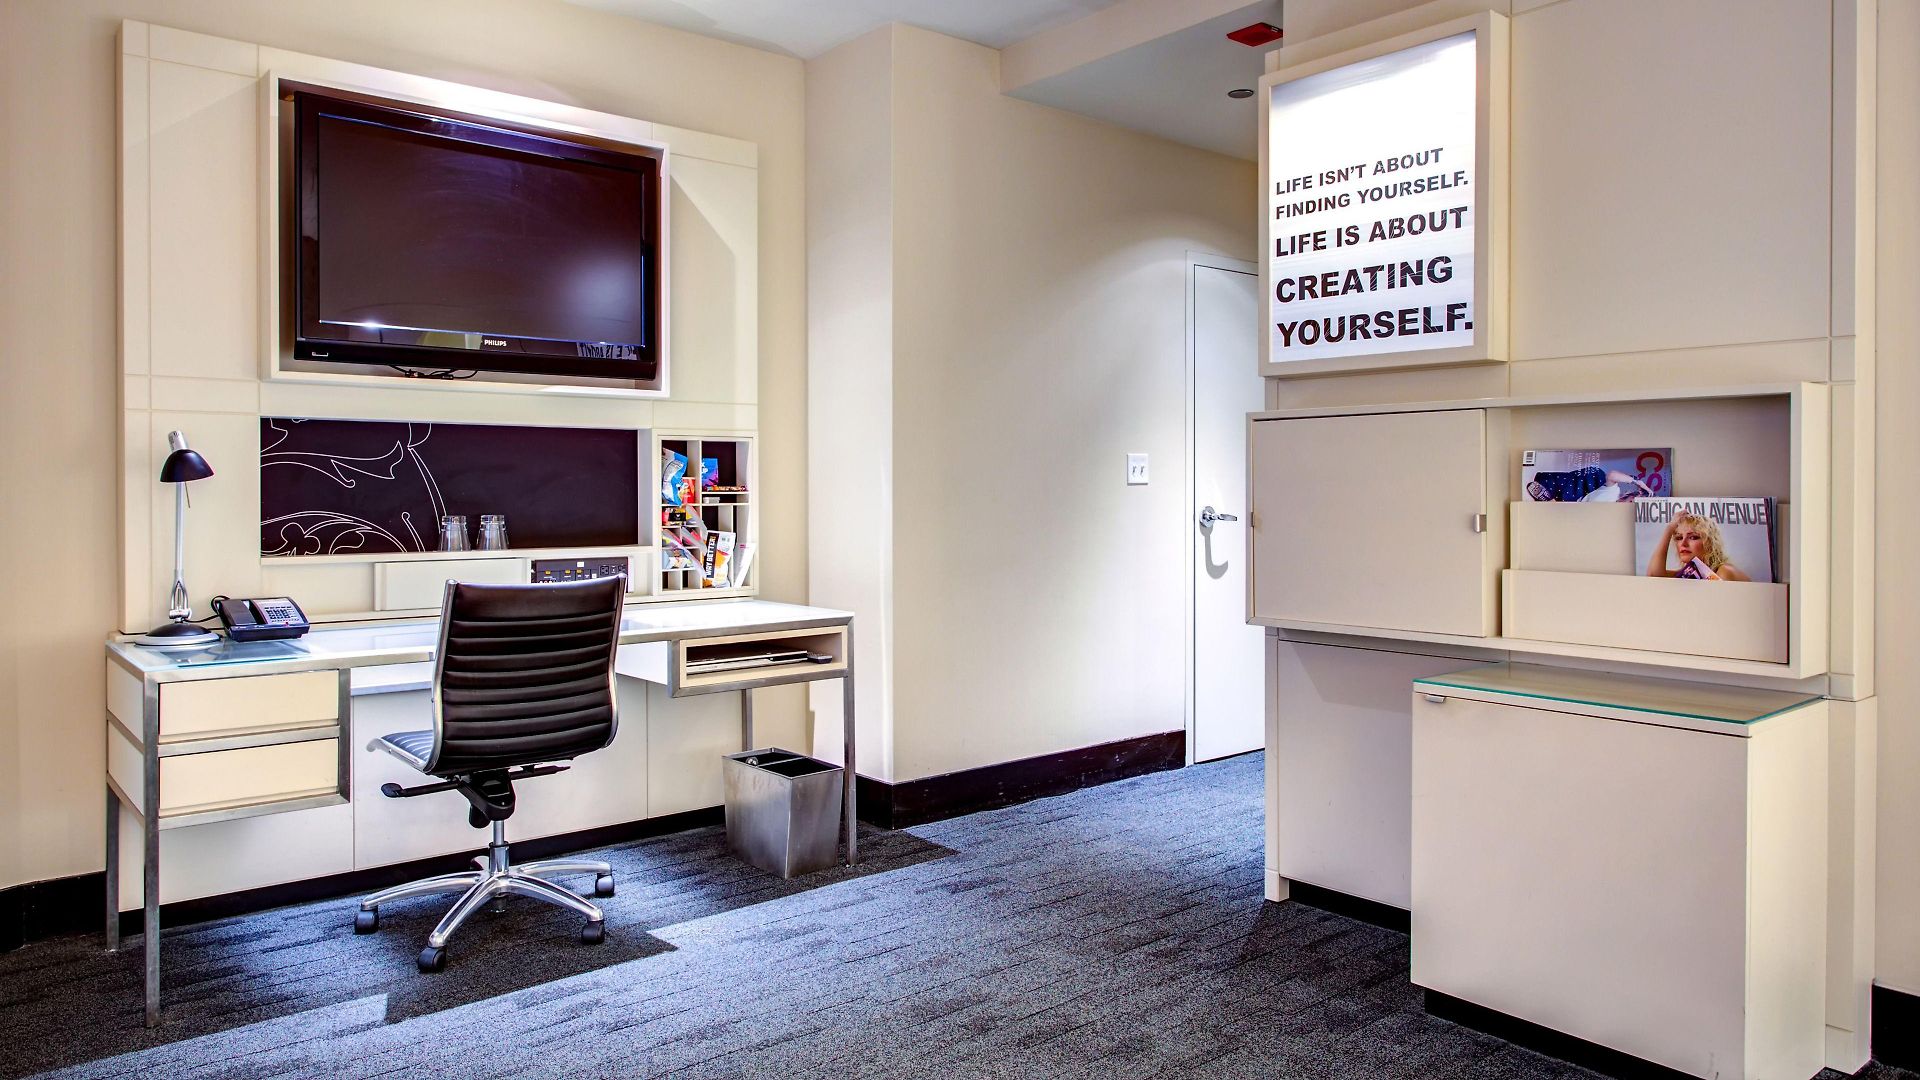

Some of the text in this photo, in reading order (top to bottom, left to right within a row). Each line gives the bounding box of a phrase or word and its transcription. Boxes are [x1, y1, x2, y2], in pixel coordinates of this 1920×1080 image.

[1276, 147, 1444, 195] LIFE ISN'T ABOUT
[1276, 170, 1468, 220] FINDING YOURSELF.
[1276, 206, 1468, 257] LIFE IS ABOUT
[1276, 255, 1453, 303] CREATING
[484, 339, 507, 347] PHILIPS
[1276, 302, 1473, 347] YOURSELF.
[1636, 452, 1664, 492] CS
[1635, 502, 1768, 525] MICHIGAN AVENUE
